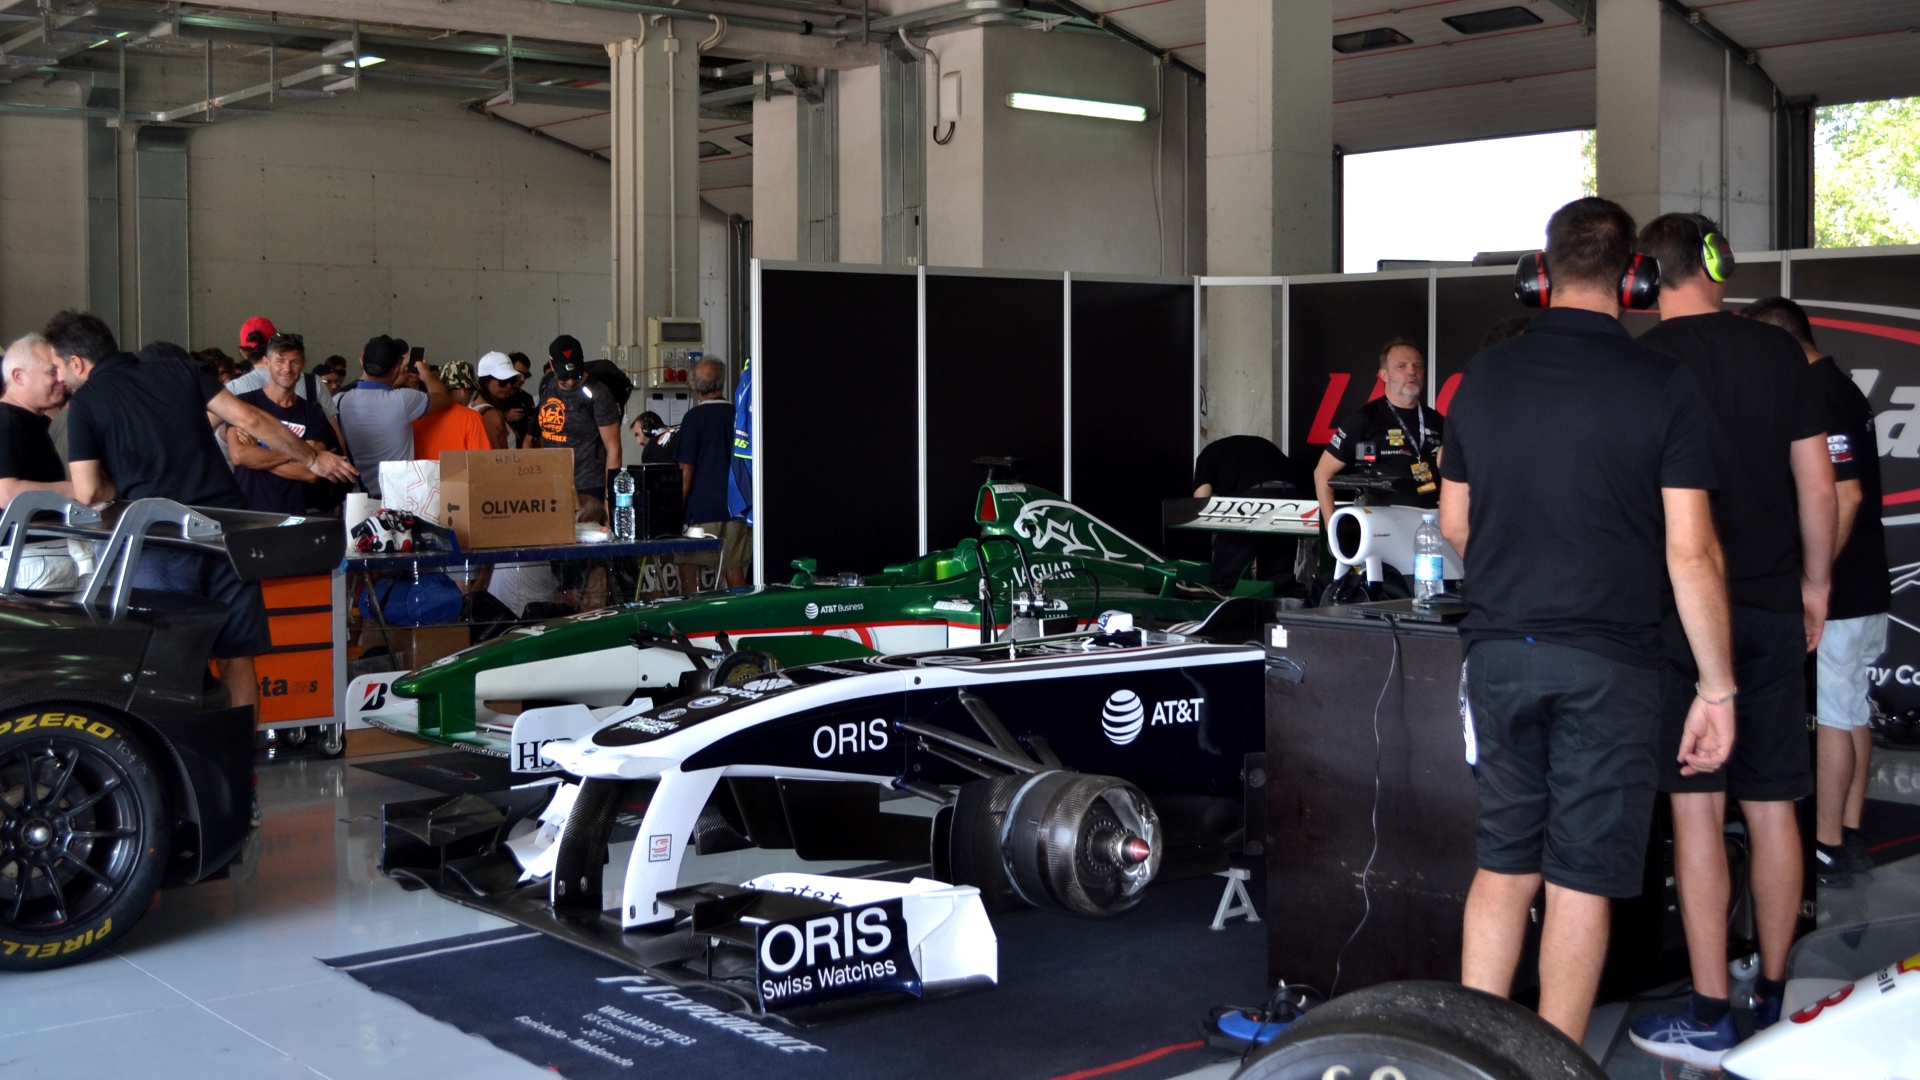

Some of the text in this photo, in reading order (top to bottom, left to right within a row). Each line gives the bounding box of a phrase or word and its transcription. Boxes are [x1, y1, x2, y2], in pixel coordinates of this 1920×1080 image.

[517, 465, 543, 476] 2023
[481, 499, 545, 515] OLIVARI
[1012, 561, 1075, 588] JAGUAR
[820, 603, 864, 614] AT&T Business
[257, 676, 288, 697] ta
[1866, 665, 1892, 686] ny
[1150, 698, 1204, 726] AT&T
[813, 718, 888, 759] ORIS
[0, 917, 112, 959] PIRELL
[761, 907, 892, 973] ORIS
[762, 959, 897, 1000] Swiss Watches
[596, 1019, 648, 1041] Cosworth
[643, 1037, 665, 1048] CA
[598, 1004, 698, 1046] WILLIAMS FW33
[569, 1037, 634, 1067] Maldonado
